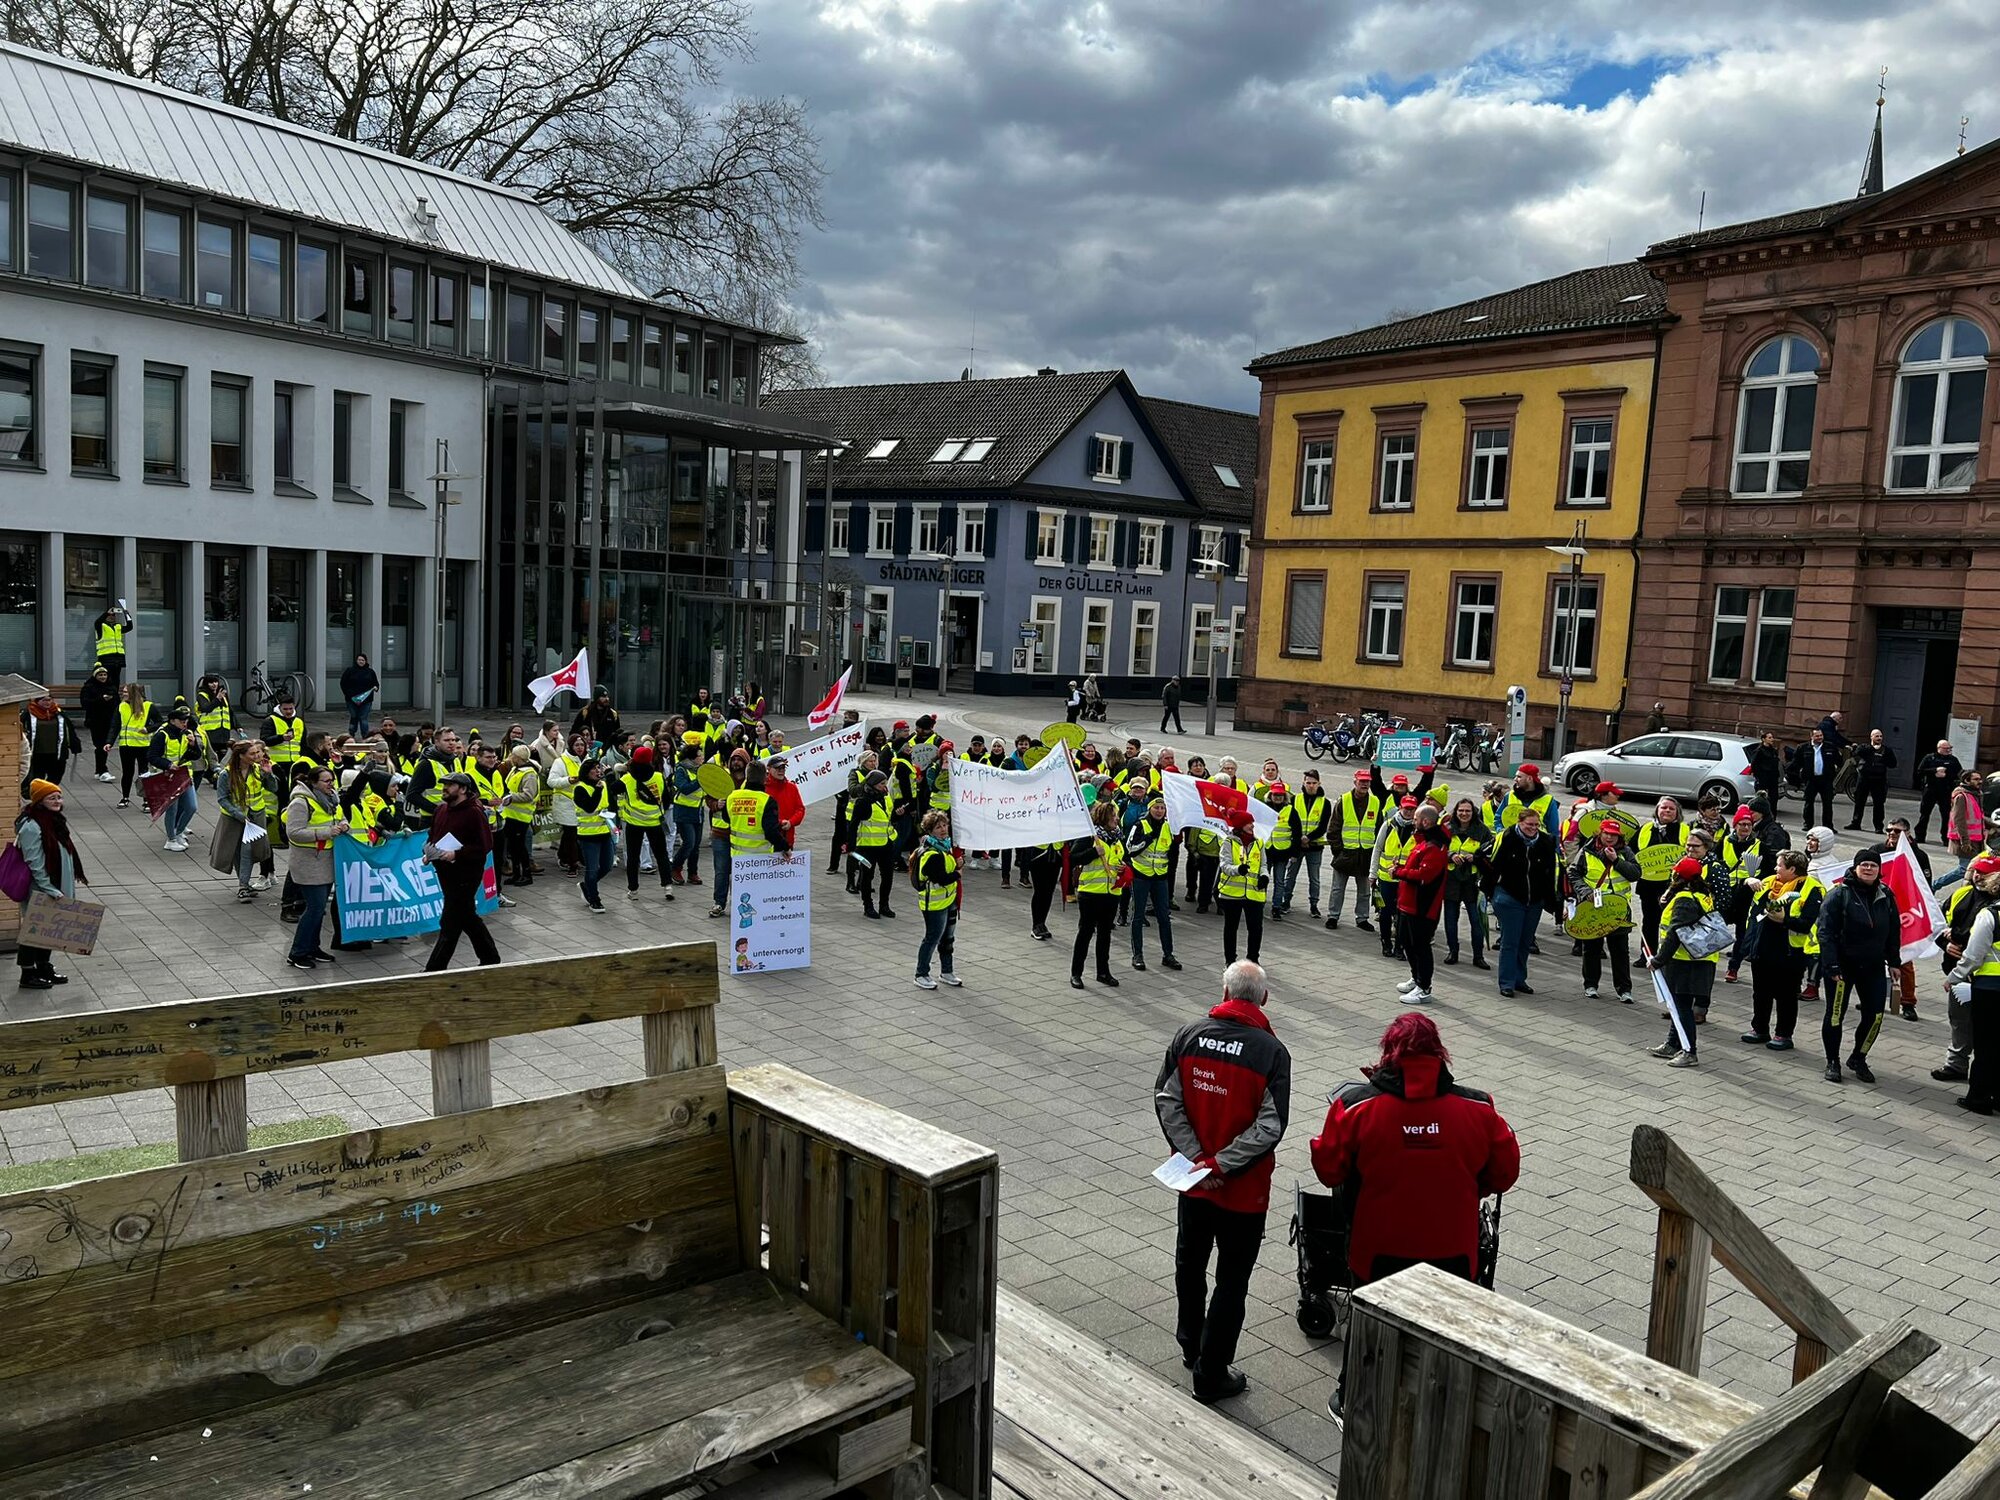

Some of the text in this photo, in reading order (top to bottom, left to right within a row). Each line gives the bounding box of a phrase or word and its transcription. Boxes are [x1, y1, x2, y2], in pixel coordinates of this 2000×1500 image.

[1039, 576, 1062, 590] DER
[1126, 583, 1153, 596] LAHR
[1382, 741, 1420, 750] ZUSAMMEN
[1382, 750, 1420, 759] GEHT MEHR
[813, 761, 832, 777] viel
[838, 753, 857, 768] mehr
[952, 762, 974, 777] Wer
[962, 789, 993, 805] Mehr
[1000, 796, 1015, 804] von
[997, 809, 1033, 820] besser
[401, 857, 444, 897] GE
[762, 894, 804, 903] unterbesetzt
[387, 905, 420, 925] NICHT
[762, 912, 804, 921] unterbezahlt
[753, 946, 804, 958] unterversorgt
[1198, 1037, 1244, 1056] ver.di
[1193, 1067, 1216, 1080] Bezirk
